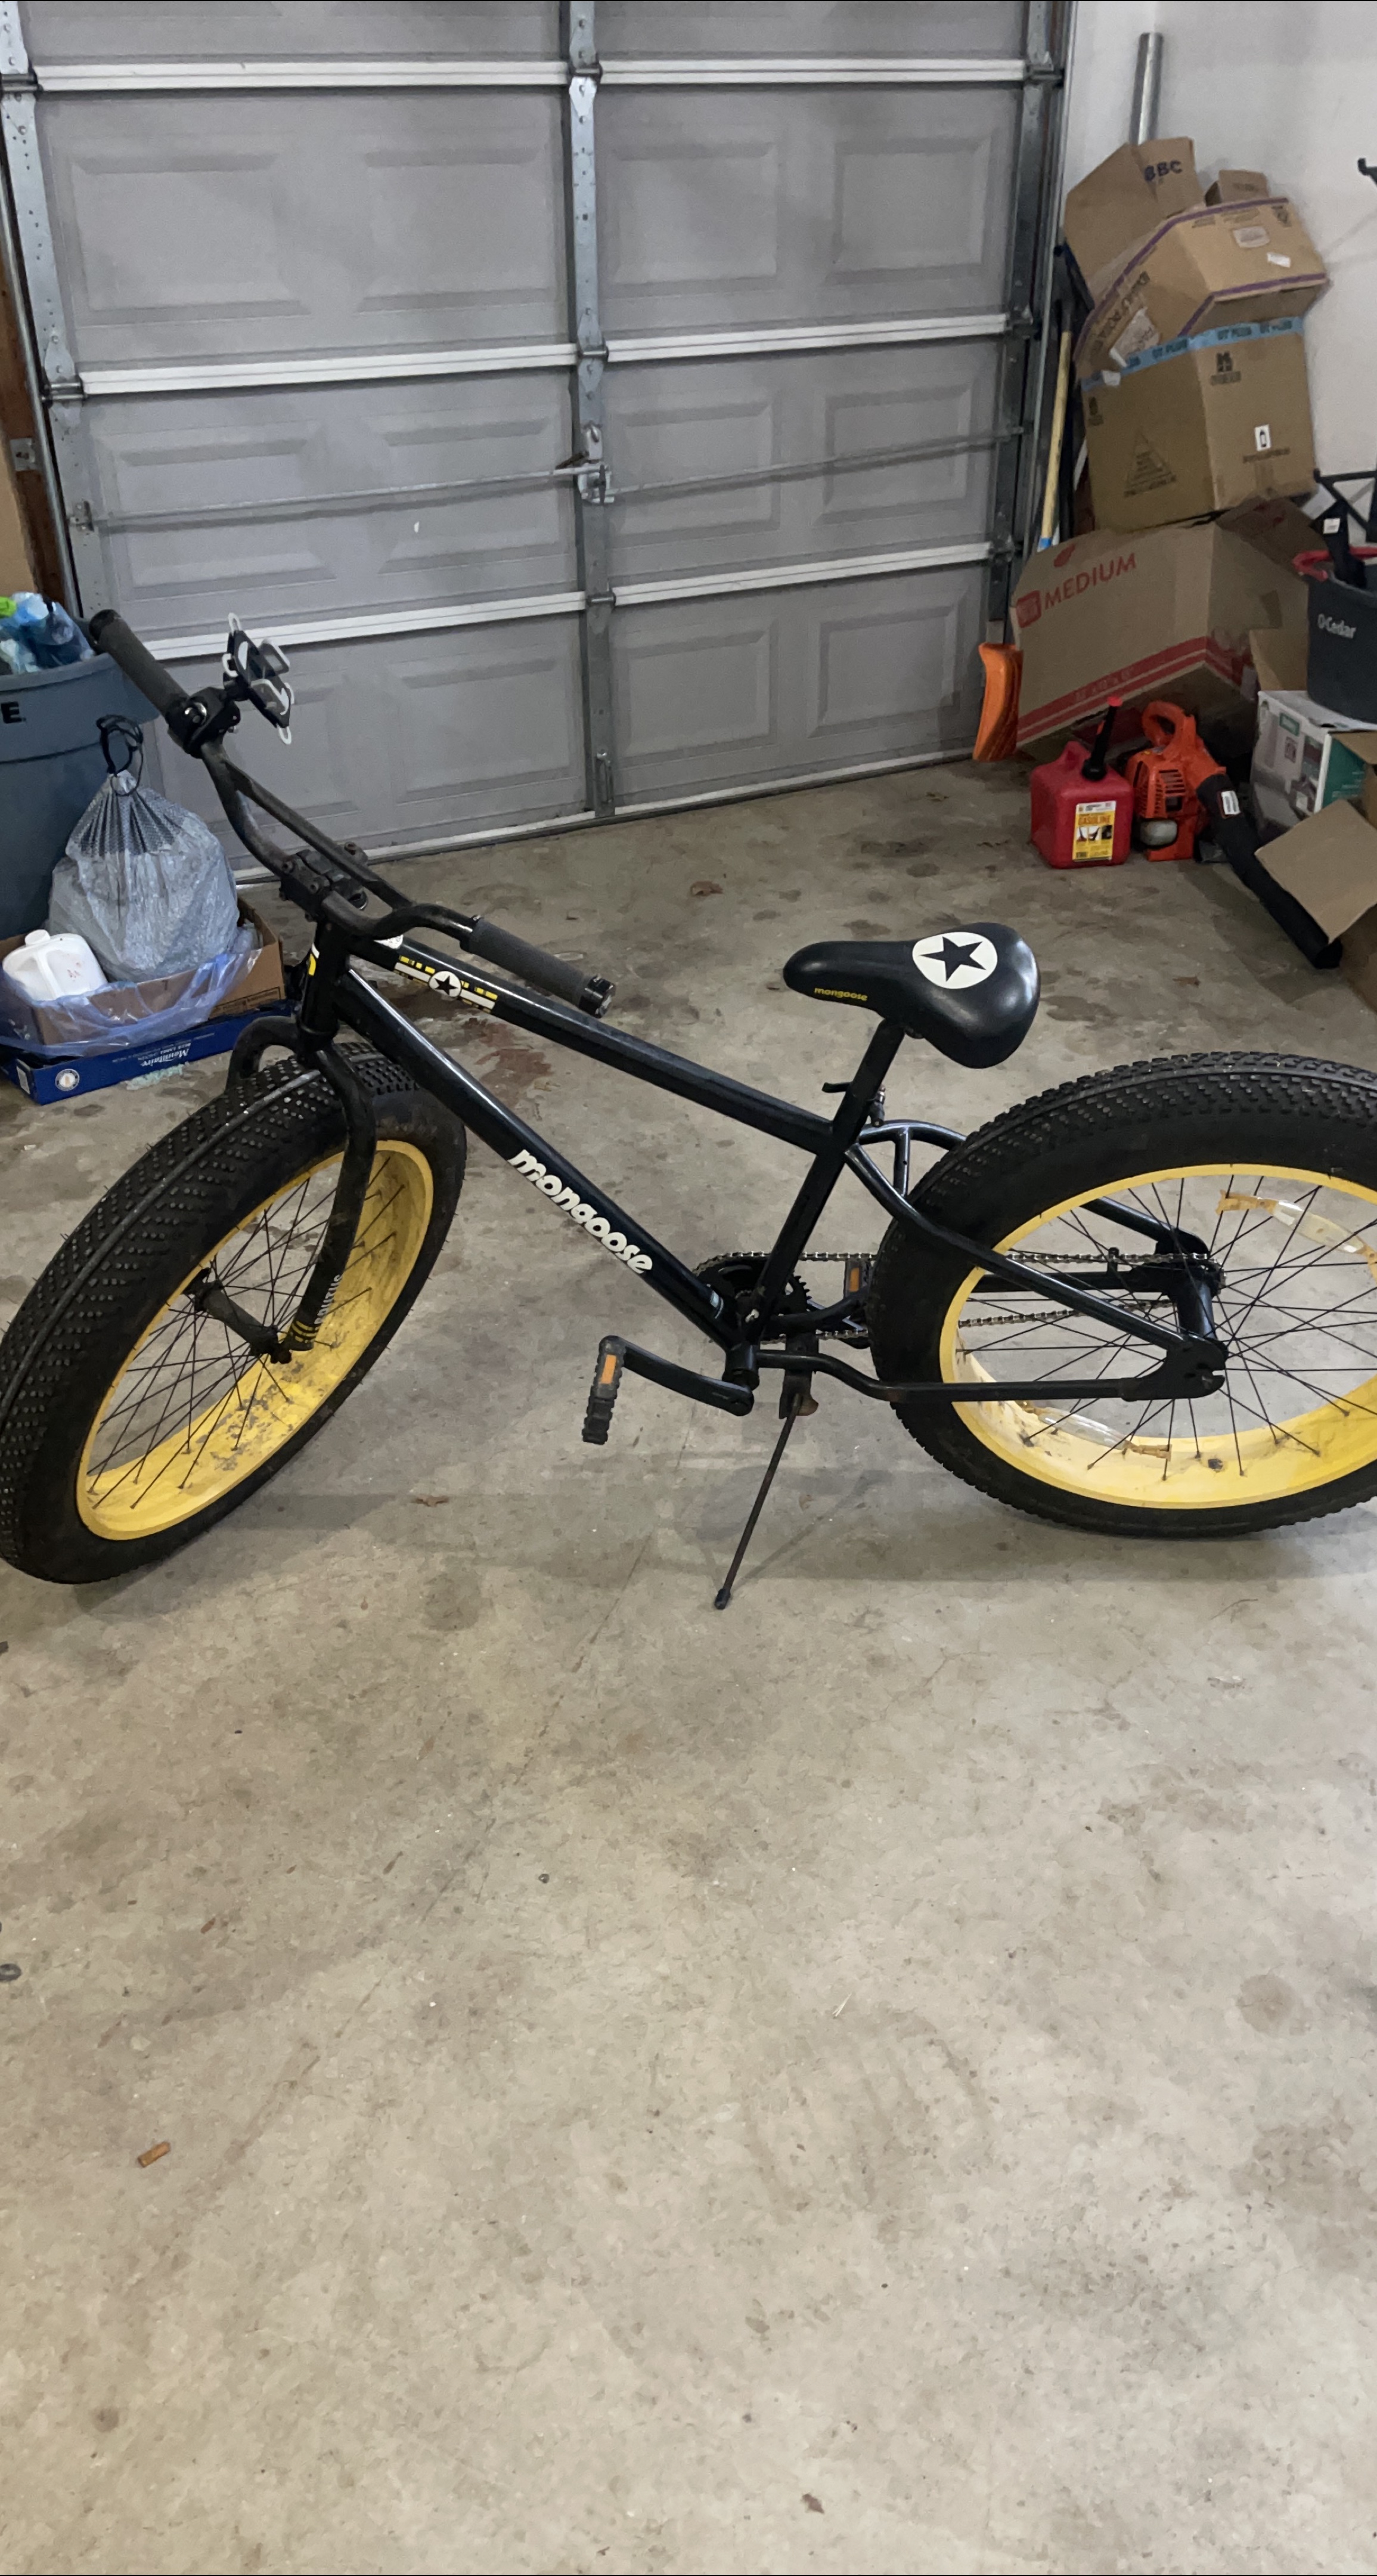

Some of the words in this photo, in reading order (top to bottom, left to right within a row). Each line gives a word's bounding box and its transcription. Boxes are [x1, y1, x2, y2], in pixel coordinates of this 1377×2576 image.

[1045, 552, 1136, 610] MEDIUM
[814, 987, 868, 1001] mongoose
[507, 1149, 653, 1274] mongoose
